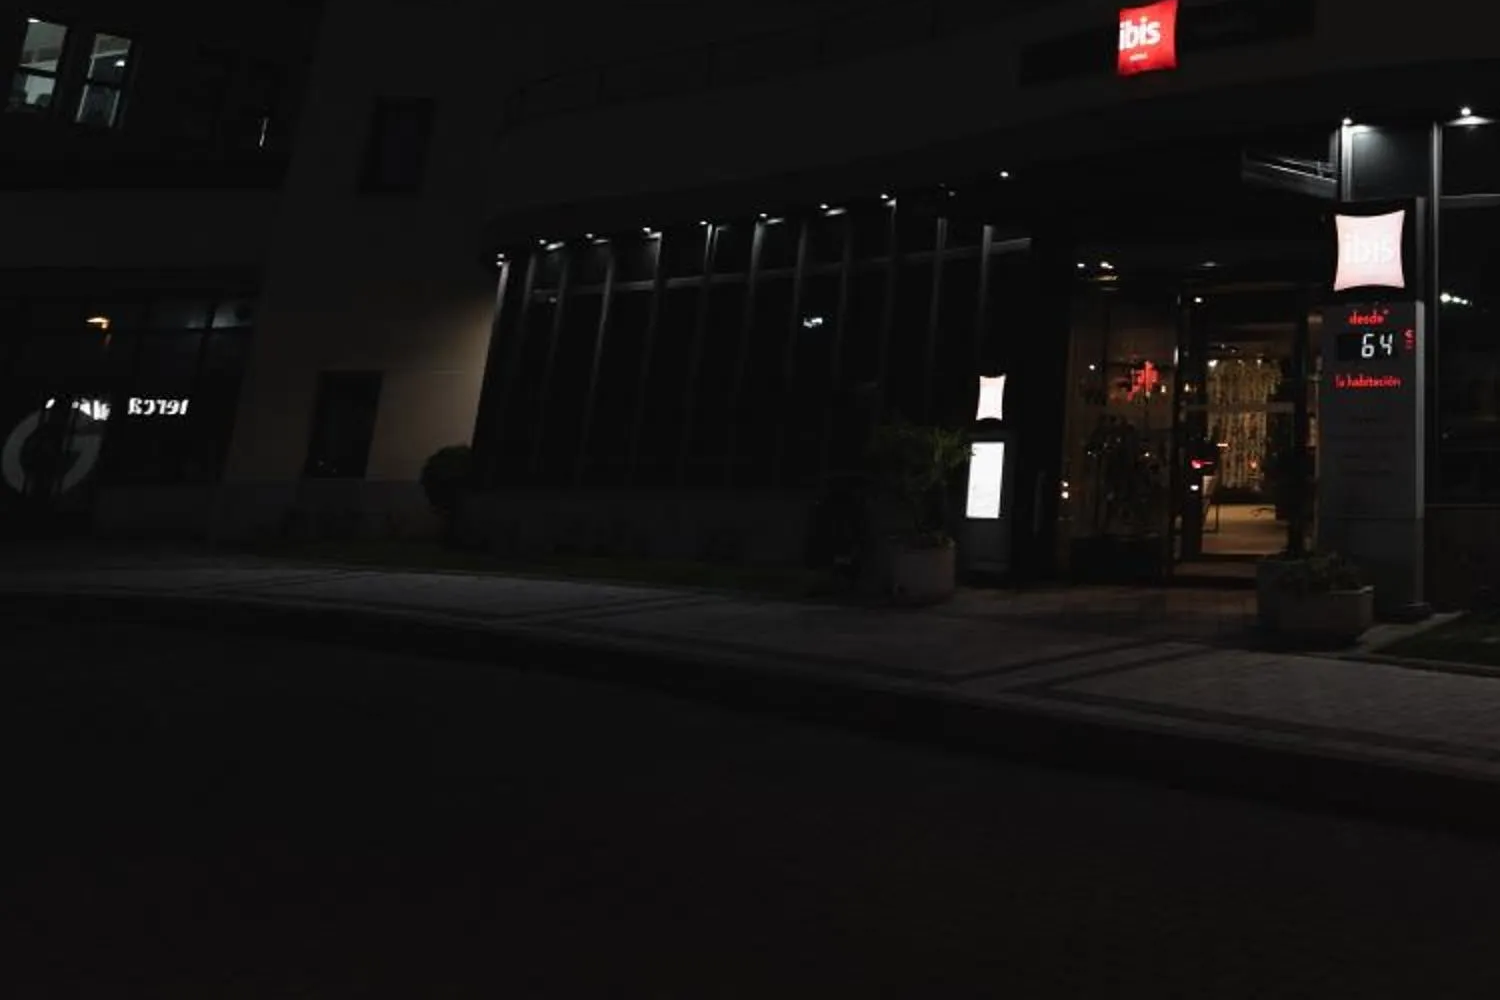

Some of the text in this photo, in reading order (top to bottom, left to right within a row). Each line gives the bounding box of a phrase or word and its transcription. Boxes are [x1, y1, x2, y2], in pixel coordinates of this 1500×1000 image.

[1119, 15, 1161, 51] ibis
[1343, 232, 1394, 264] ibis
[1361, 333, 1393, 358] 64
